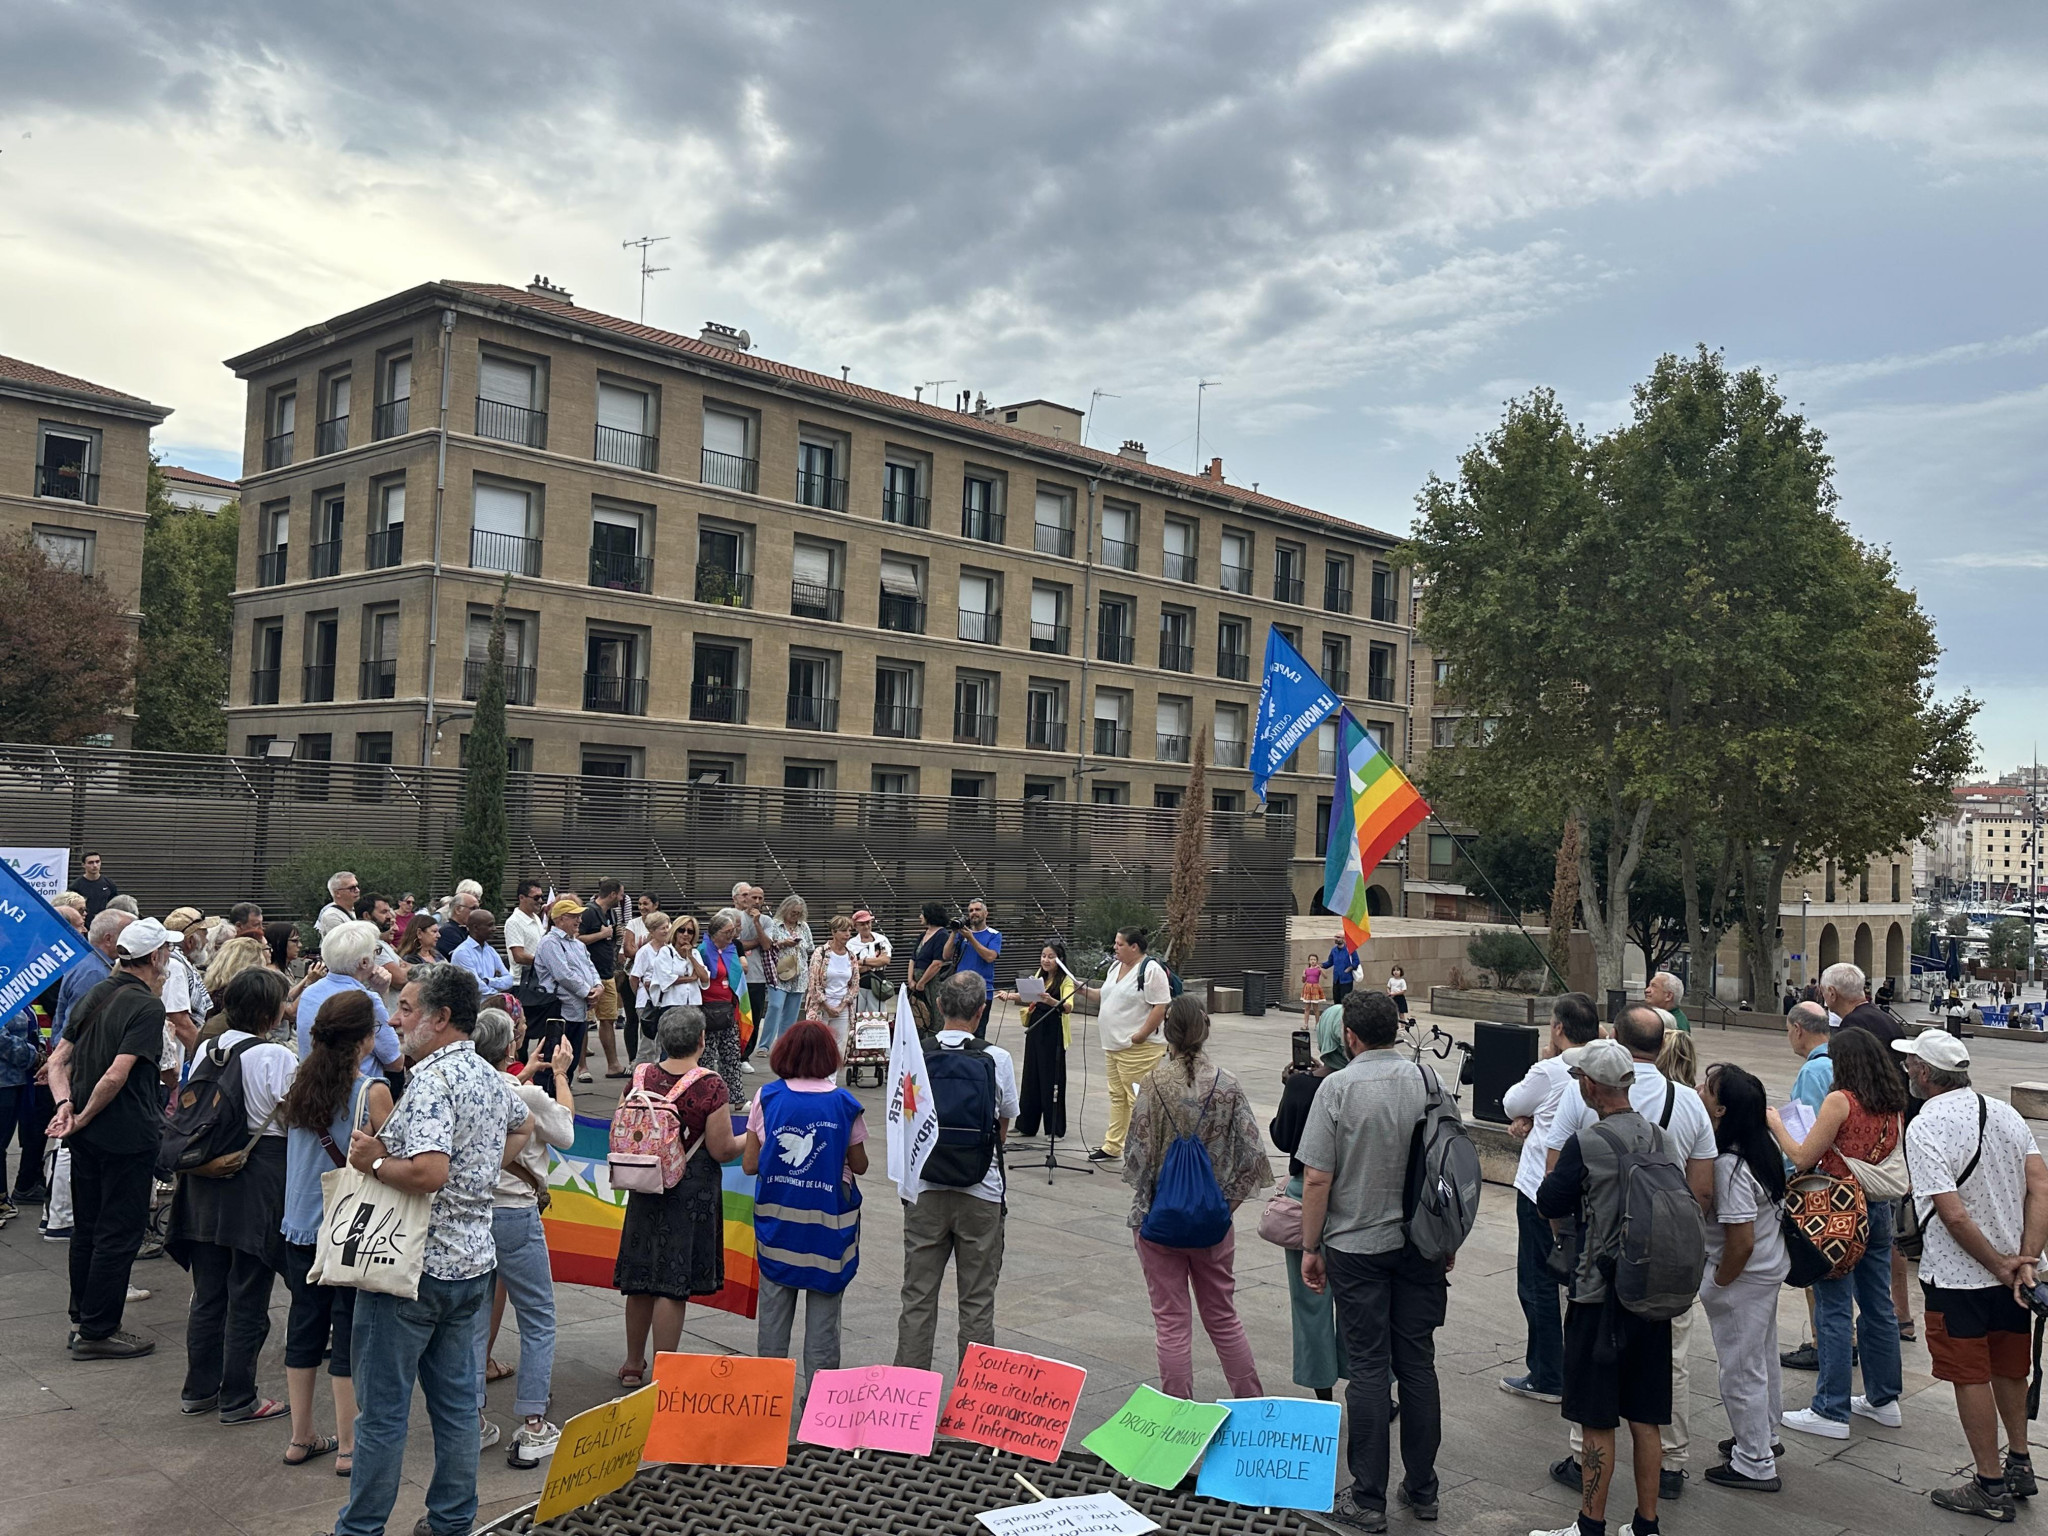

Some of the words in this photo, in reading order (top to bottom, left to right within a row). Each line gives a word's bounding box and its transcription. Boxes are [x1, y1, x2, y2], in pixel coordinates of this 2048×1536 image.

[49, 879, 58, 887] of
[788, 1159, 814, 1176] CULTIVONS
[767, 1175, 774, 1184] LE
[774, 1175, 805, 1188] MOUVEMENT
[806, 1180, 813, 1188] DE
[815, 1181, 822, 1189] LA
[822, 1183, 833, 1193] PAIX
[976, 1352, 1046, 1381] Soutenir
[658, 1386, 783, 1417] DÉMOCRATIE
[827, 1382, 932, 1407] TOLÉRANCE
[957, 1368, 968, 1388] la
[972, 1372, 998, 1394] libre
[1002, 1384, 1070, 1412] circulation
[814, 1409, 923, 1430] SOLIDARITÉ
[956, 1393, 976, 1411] des
[980, 1402, 1067, 1434] connaissances
[940, 1415, 953, 1428] et
[954, 1417, 965, 1430] de
[972, 1414, 1058, 1451] l'information
[1119, 1412, 1160, 1438] DROITS
[1160, 1425, 1205, 1447] HUMAINS
[1212, 1426, 1337, 1456] DÉVELOPPEMENT
[1235, 1458, 1310, 1480] DURABLE
[1057, 1518, 1075, 1527] la
